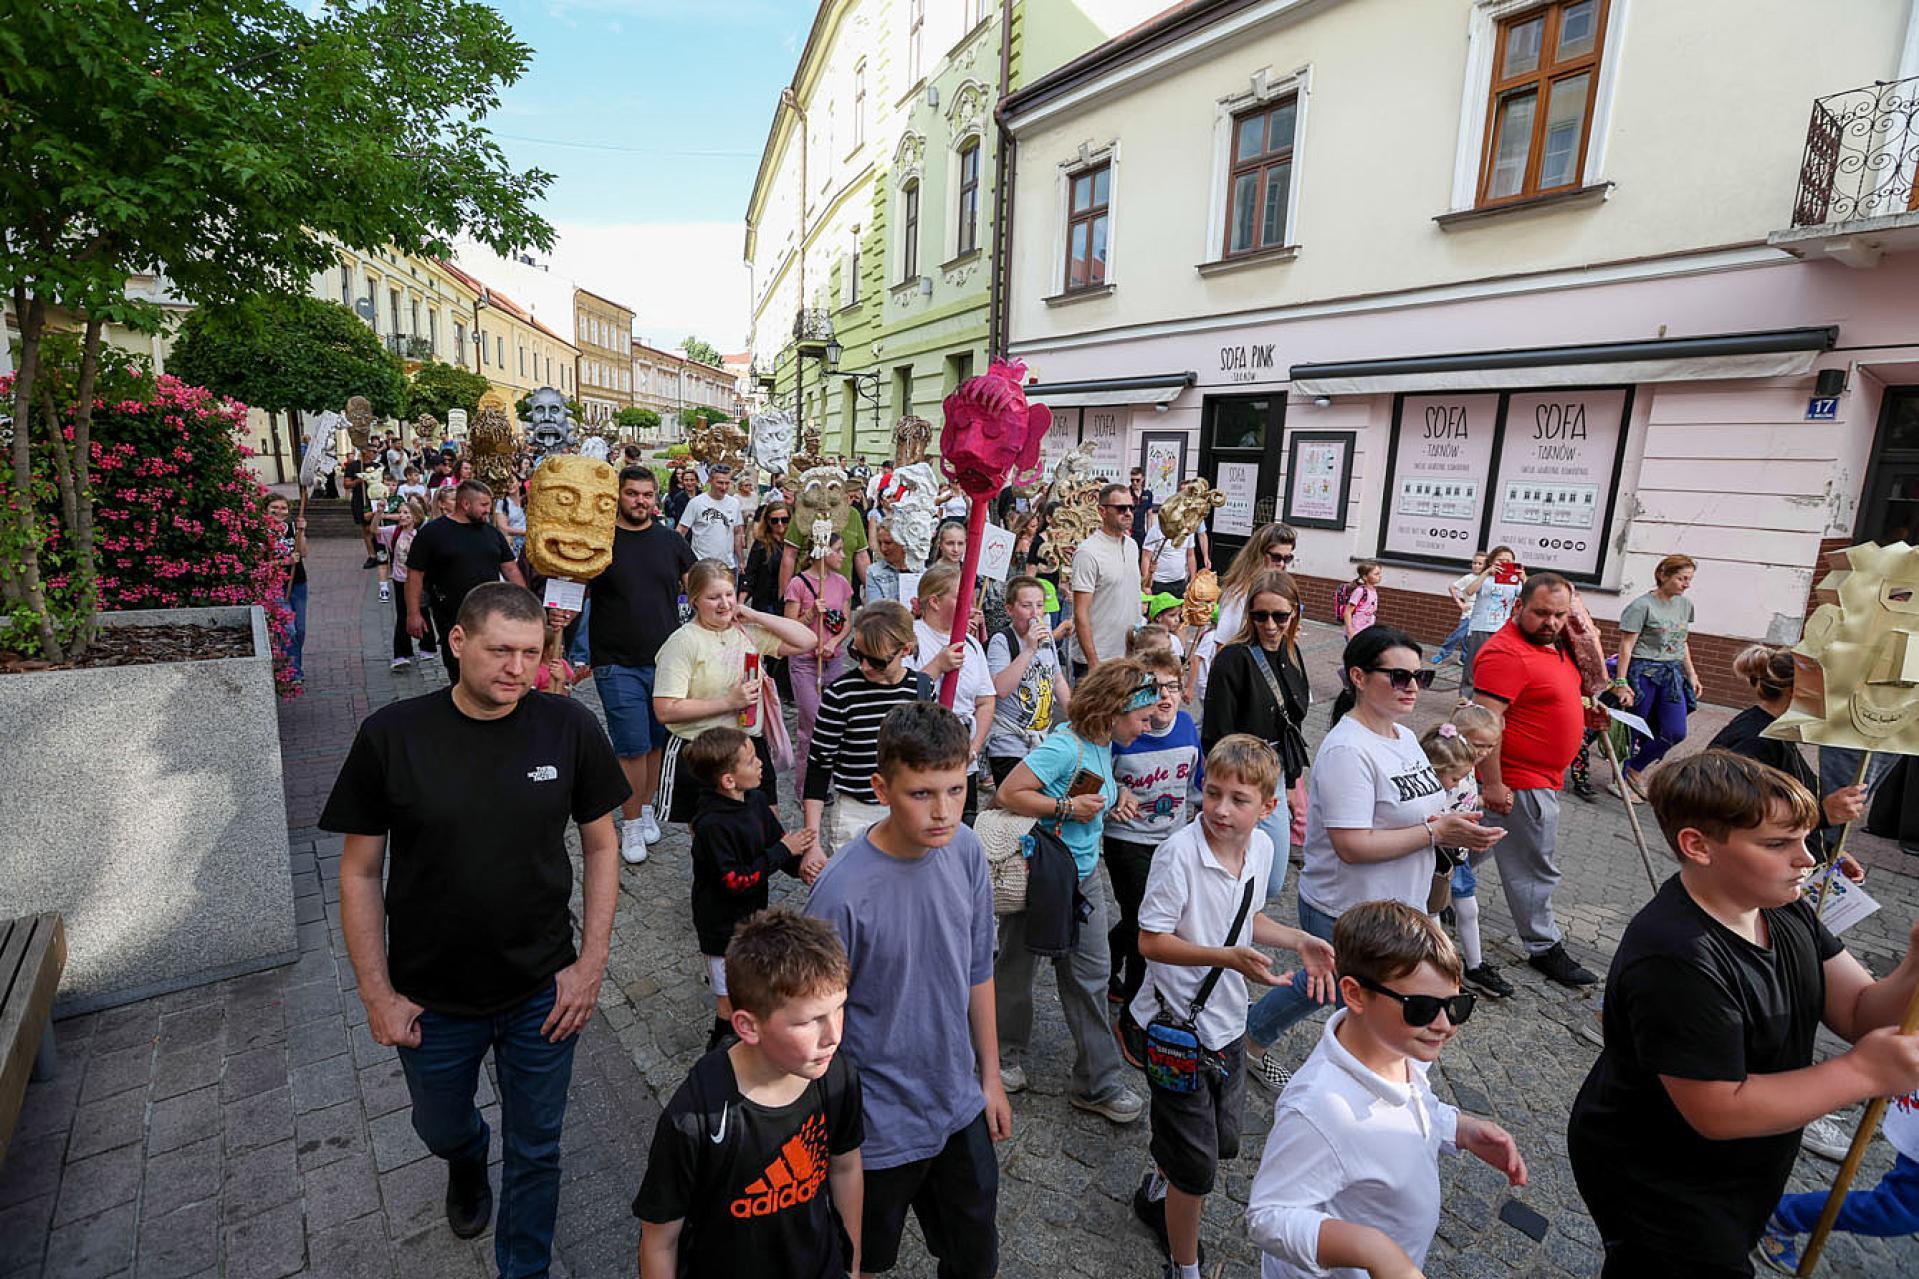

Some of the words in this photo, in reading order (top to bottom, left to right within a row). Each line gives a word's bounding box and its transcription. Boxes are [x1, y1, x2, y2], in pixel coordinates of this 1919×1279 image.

[1220, 346, 1246, 371] SOFA
[1251, 343, 1276, 368] PINK
[1815, 399, 1836, 414] 17
[1094, 413, 1116, 438] SOFA
[1423, 405, 1468, 440] SOFA
[1532, 403, 1587, 441] SOFA
